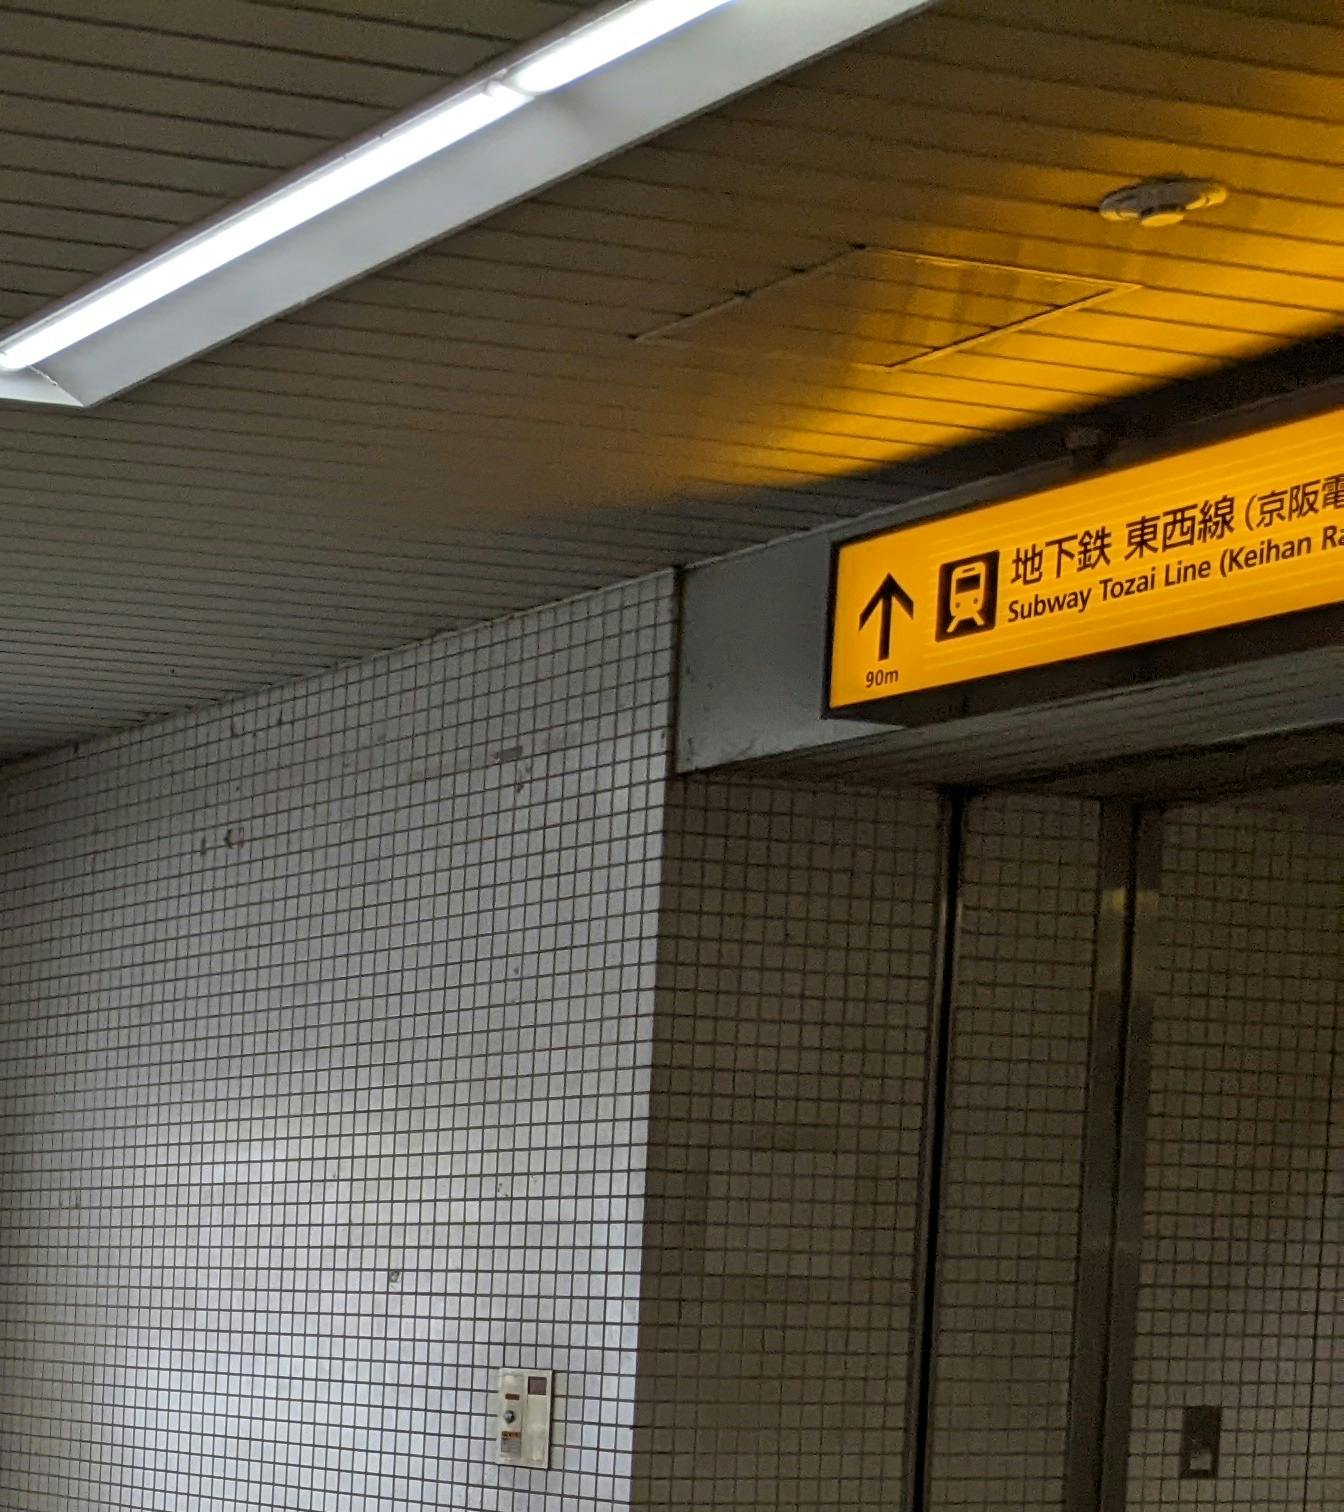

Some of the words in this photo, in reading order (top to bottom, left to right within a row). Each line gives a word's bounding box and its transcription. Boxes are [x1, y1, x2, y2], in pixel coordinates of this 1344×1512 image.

[1008, 588, 1092, 623] Subway
[1099, 567, 1156, 601] Tozai
[1165, 560, 1211, 587] Line
[1219, 537, 1312, 577] (Keihan
[1010, 526, 1112, 586] 地下鉄
[1124, 494, 1235, 561] 東西線
[865, 669, 899, 689] 90m
